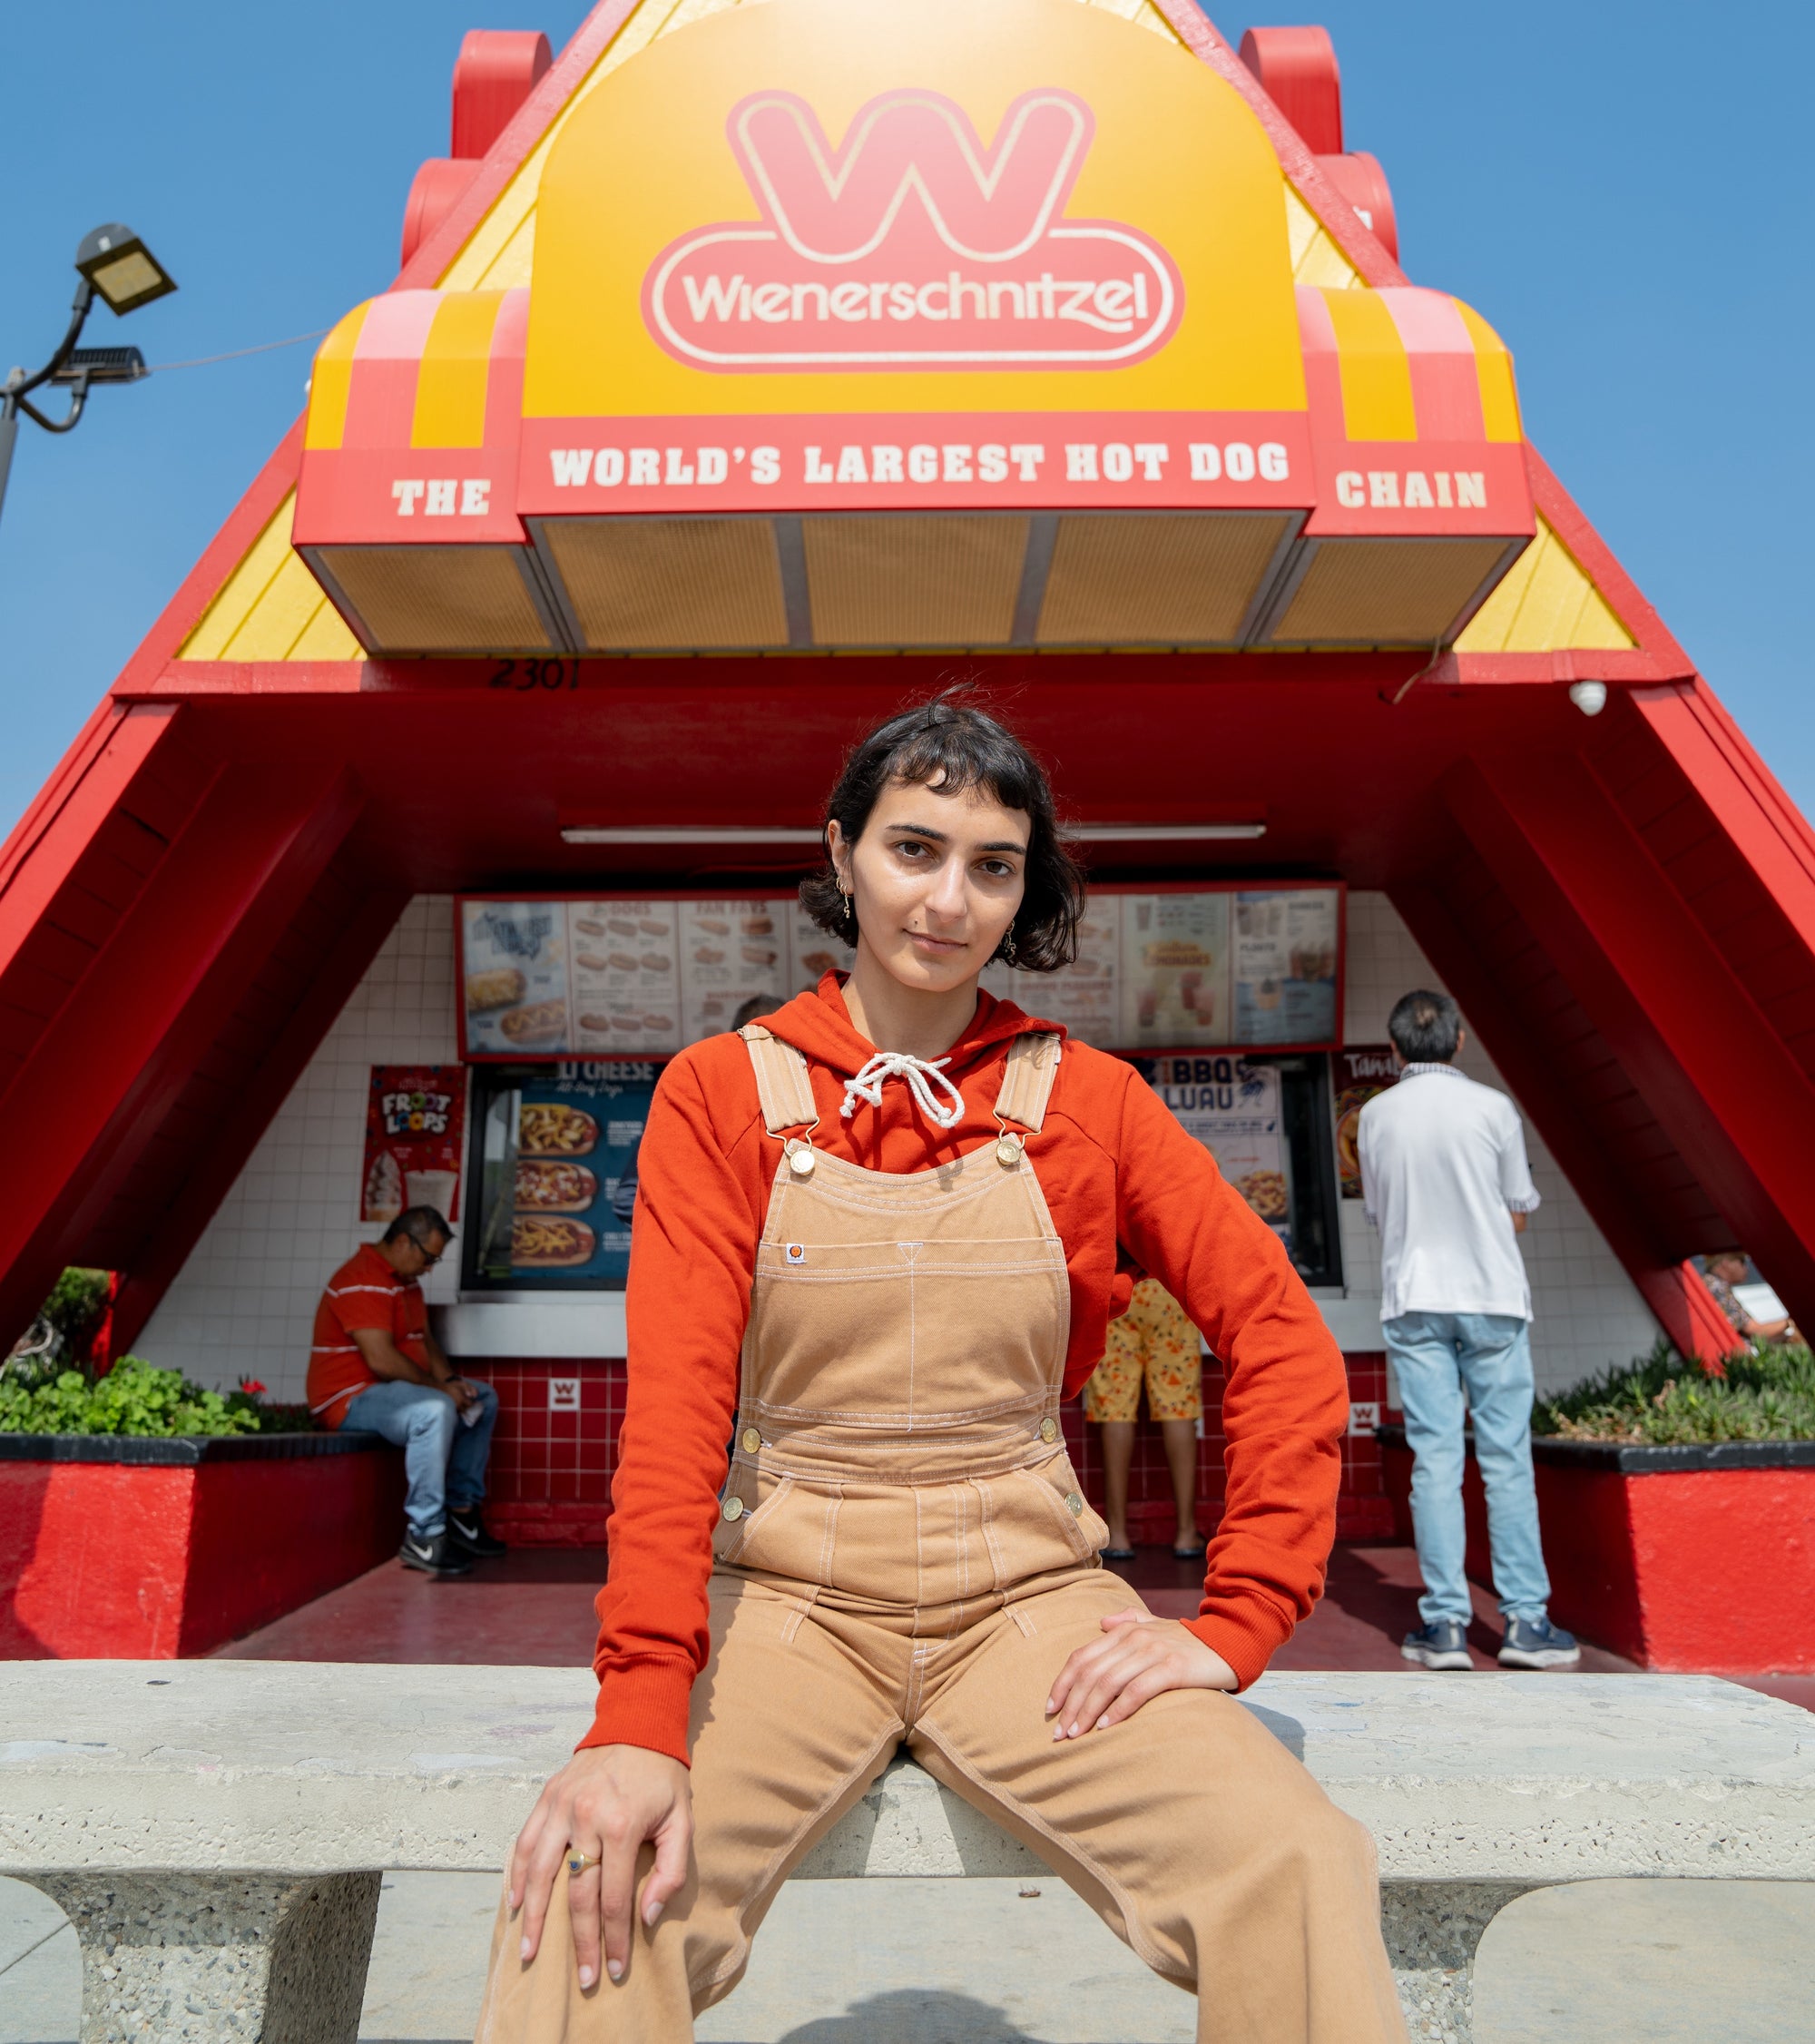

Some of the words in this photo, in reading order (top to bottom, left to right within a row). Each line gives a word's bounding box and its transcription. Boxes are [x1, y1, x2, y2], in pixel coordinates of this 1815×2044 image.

[681, 271, 1149, 334] Wienerschnitzel
[391, 479, 491, 516] THE
[549, 446, 782, 487] WORLD'S
[804, 444, 1045, 484] LARGEST
[1064, 442, 1169, 483] HOT
[1189, 442, 1290, 482] DOG
[1335, 470, 1487, 508] CHAIN
[488, 658, 580, 691] 2301
[583, 1061, 654, 1080] CHEESE
[382, 1091, 452, 1116] FROOT
[1164, 1086, 1233, 1110] LUAU
[386, 1111, 449, 1135] LOOPS
[555, 1383, 574, 1395] W
[1355, 1407, 1373, 1419] W
